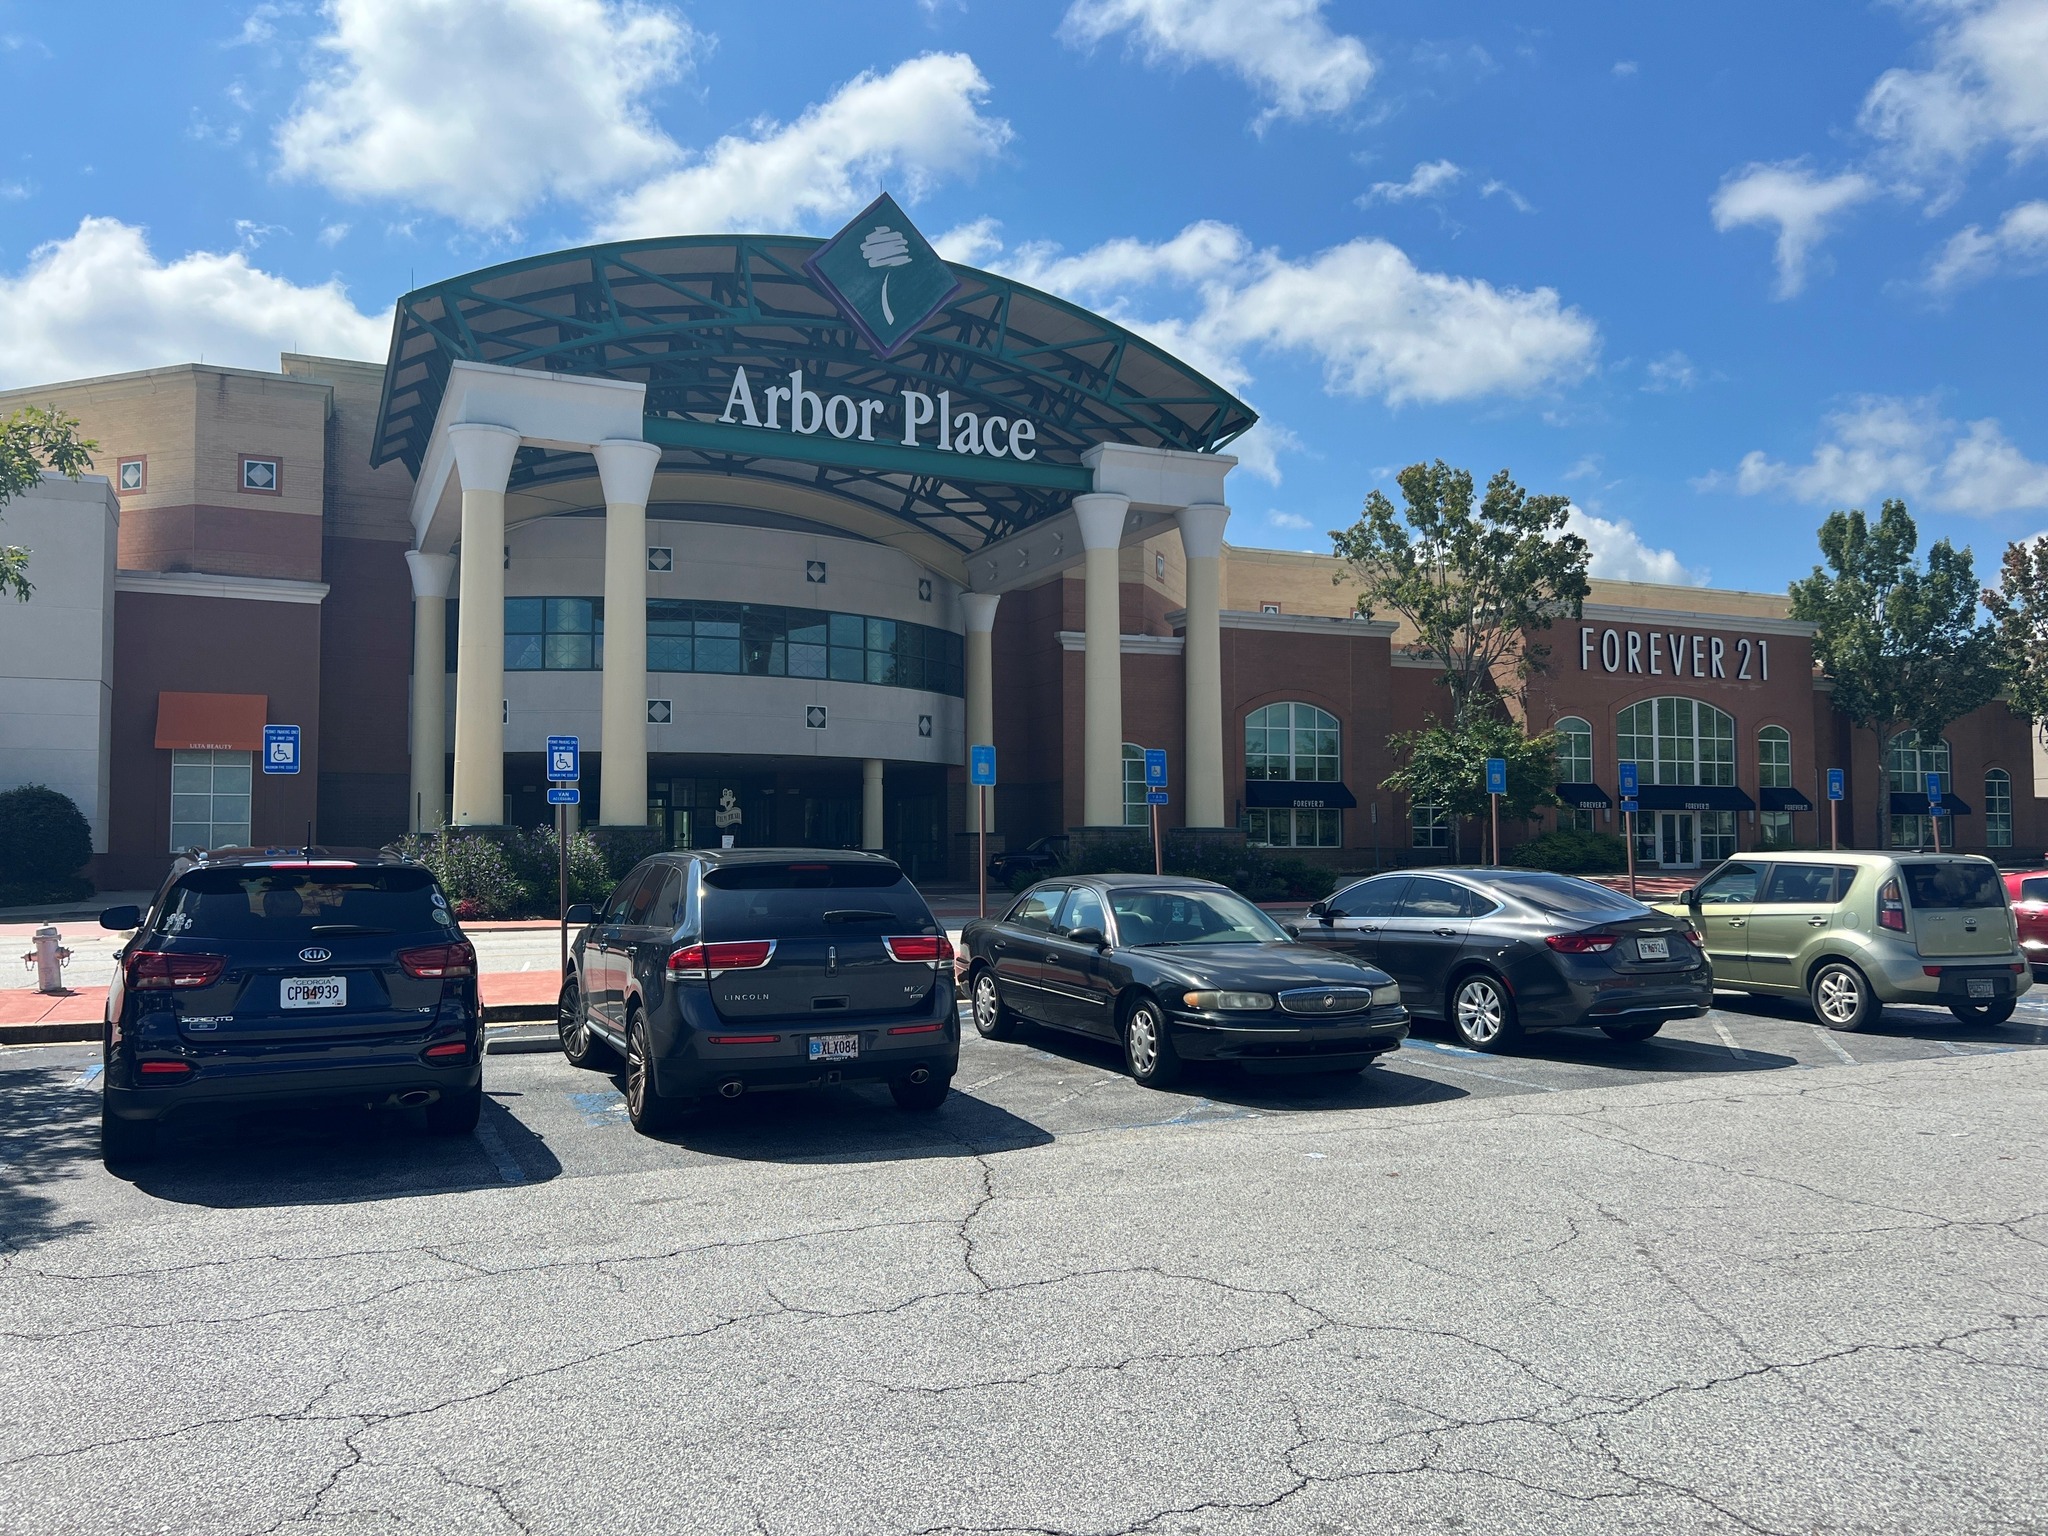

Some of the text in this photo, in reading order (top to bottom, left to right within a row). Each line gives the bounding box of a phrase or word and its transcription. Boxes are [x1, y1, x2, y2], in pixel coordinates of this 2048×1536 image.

[719, 365, 1037, 461] Arbor Place
[1581, 627, 1768, 681] FOREVER 21
[1293, 800, 1318, 808] FOREVER
[1580, 801, 1601, 809] FOREVER
[1685, 802, 1705, 810] FOREVER
[304, 950, 327, 959] KIA
[287, 985, 339, 1001] CPB4939
[724, 993, 769, 1001] LINCOLN
[821, 1040, 857, 1055] XLX084
